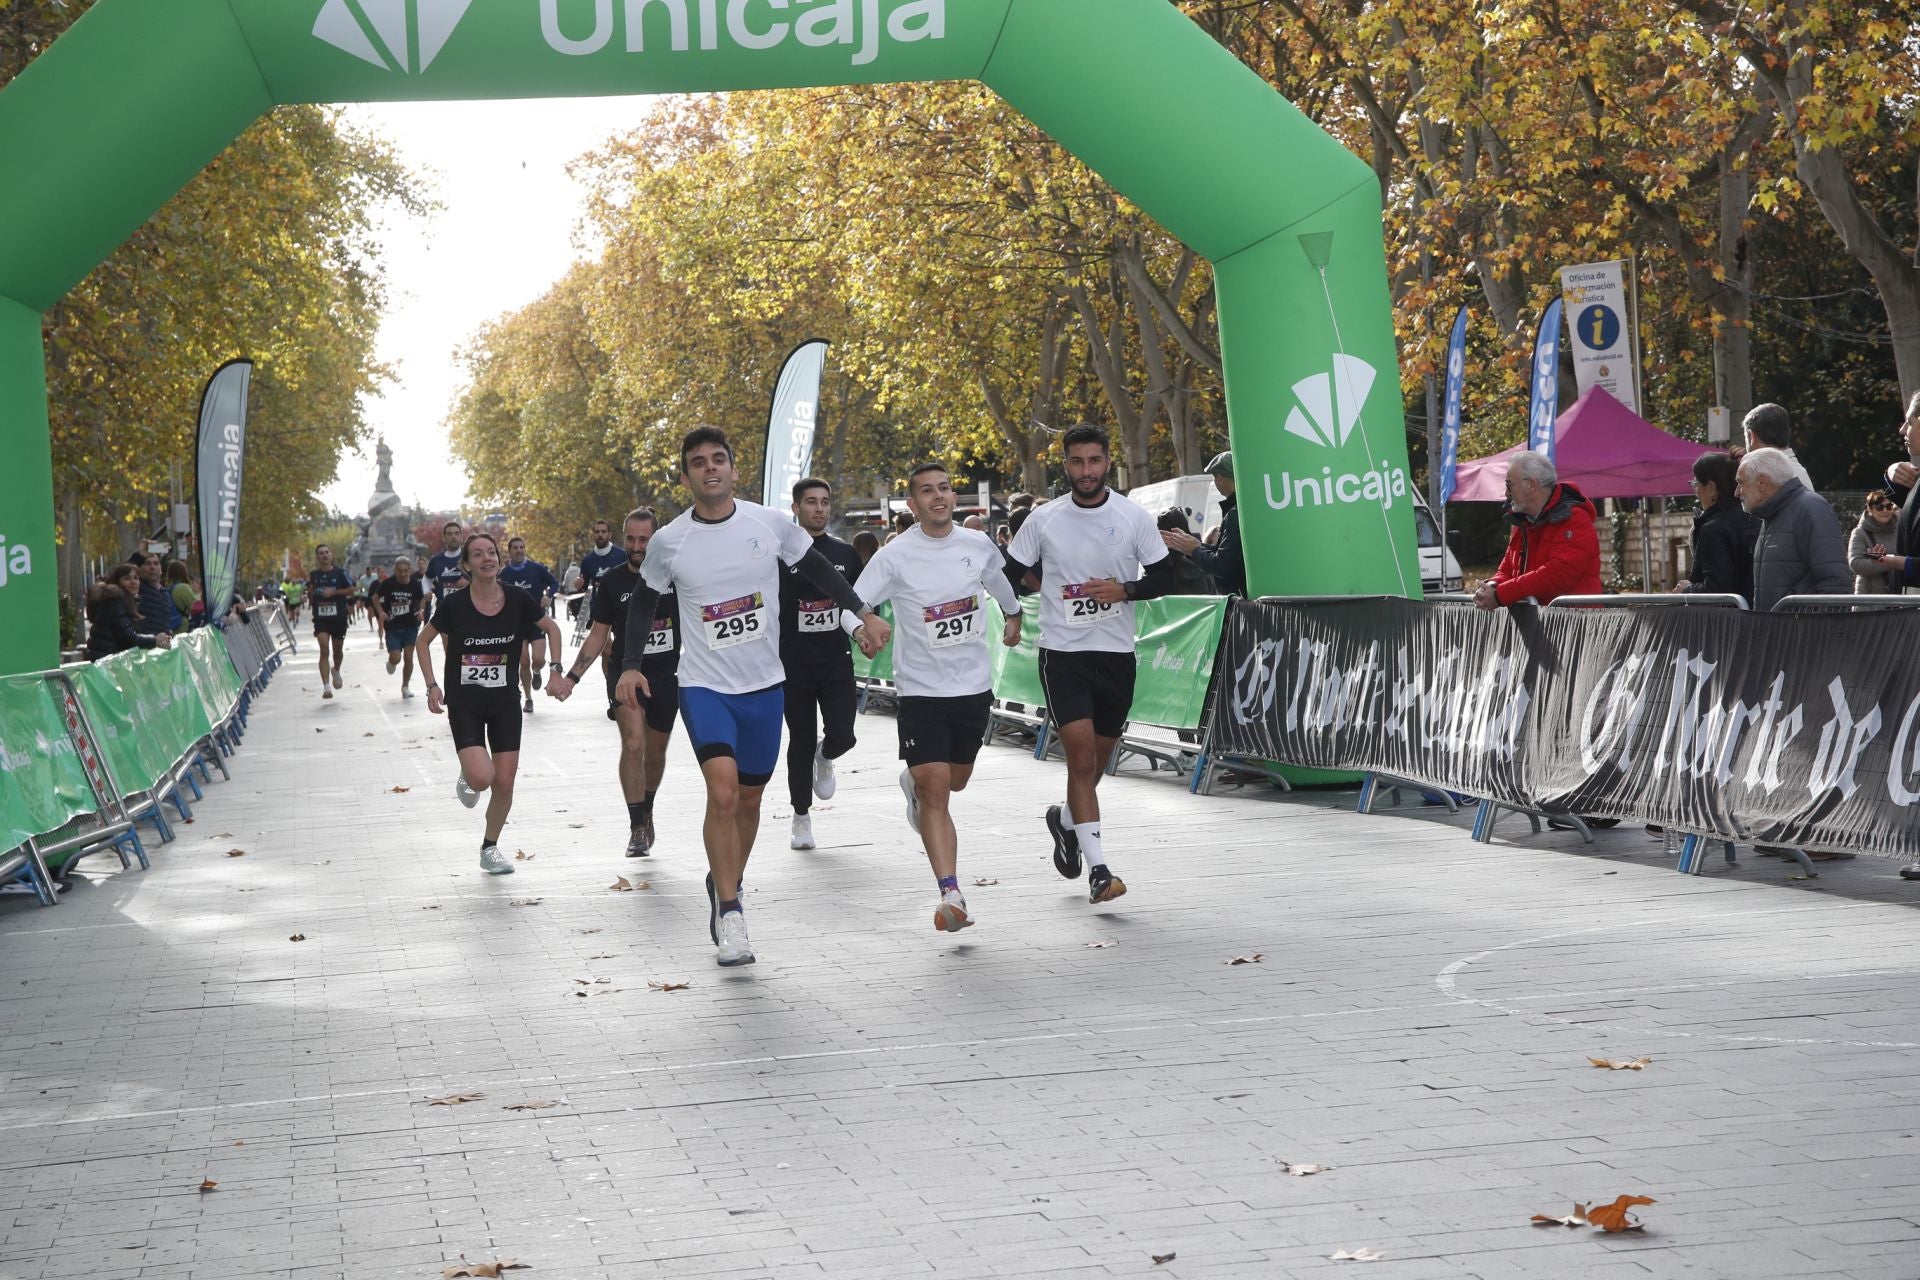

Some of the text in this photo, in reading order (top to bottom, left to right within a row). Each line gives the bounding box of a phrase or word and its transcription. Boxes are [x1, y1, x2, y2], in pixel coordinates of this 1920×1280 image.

[540, 0, 946, 65] Unicaja
[1568, 271, 1606, 283] Oficina de
[1263, 459, 1406, 510] Unicaja
[713, 612, 759, 640] 295
[804, 610, 834, 626] 241
[935, 613, 973, 640] 297
[467, 666, 500, 681] 243
[1653, 647, 1804, 797] Norte
[1806, 674, 1883, 802] de
